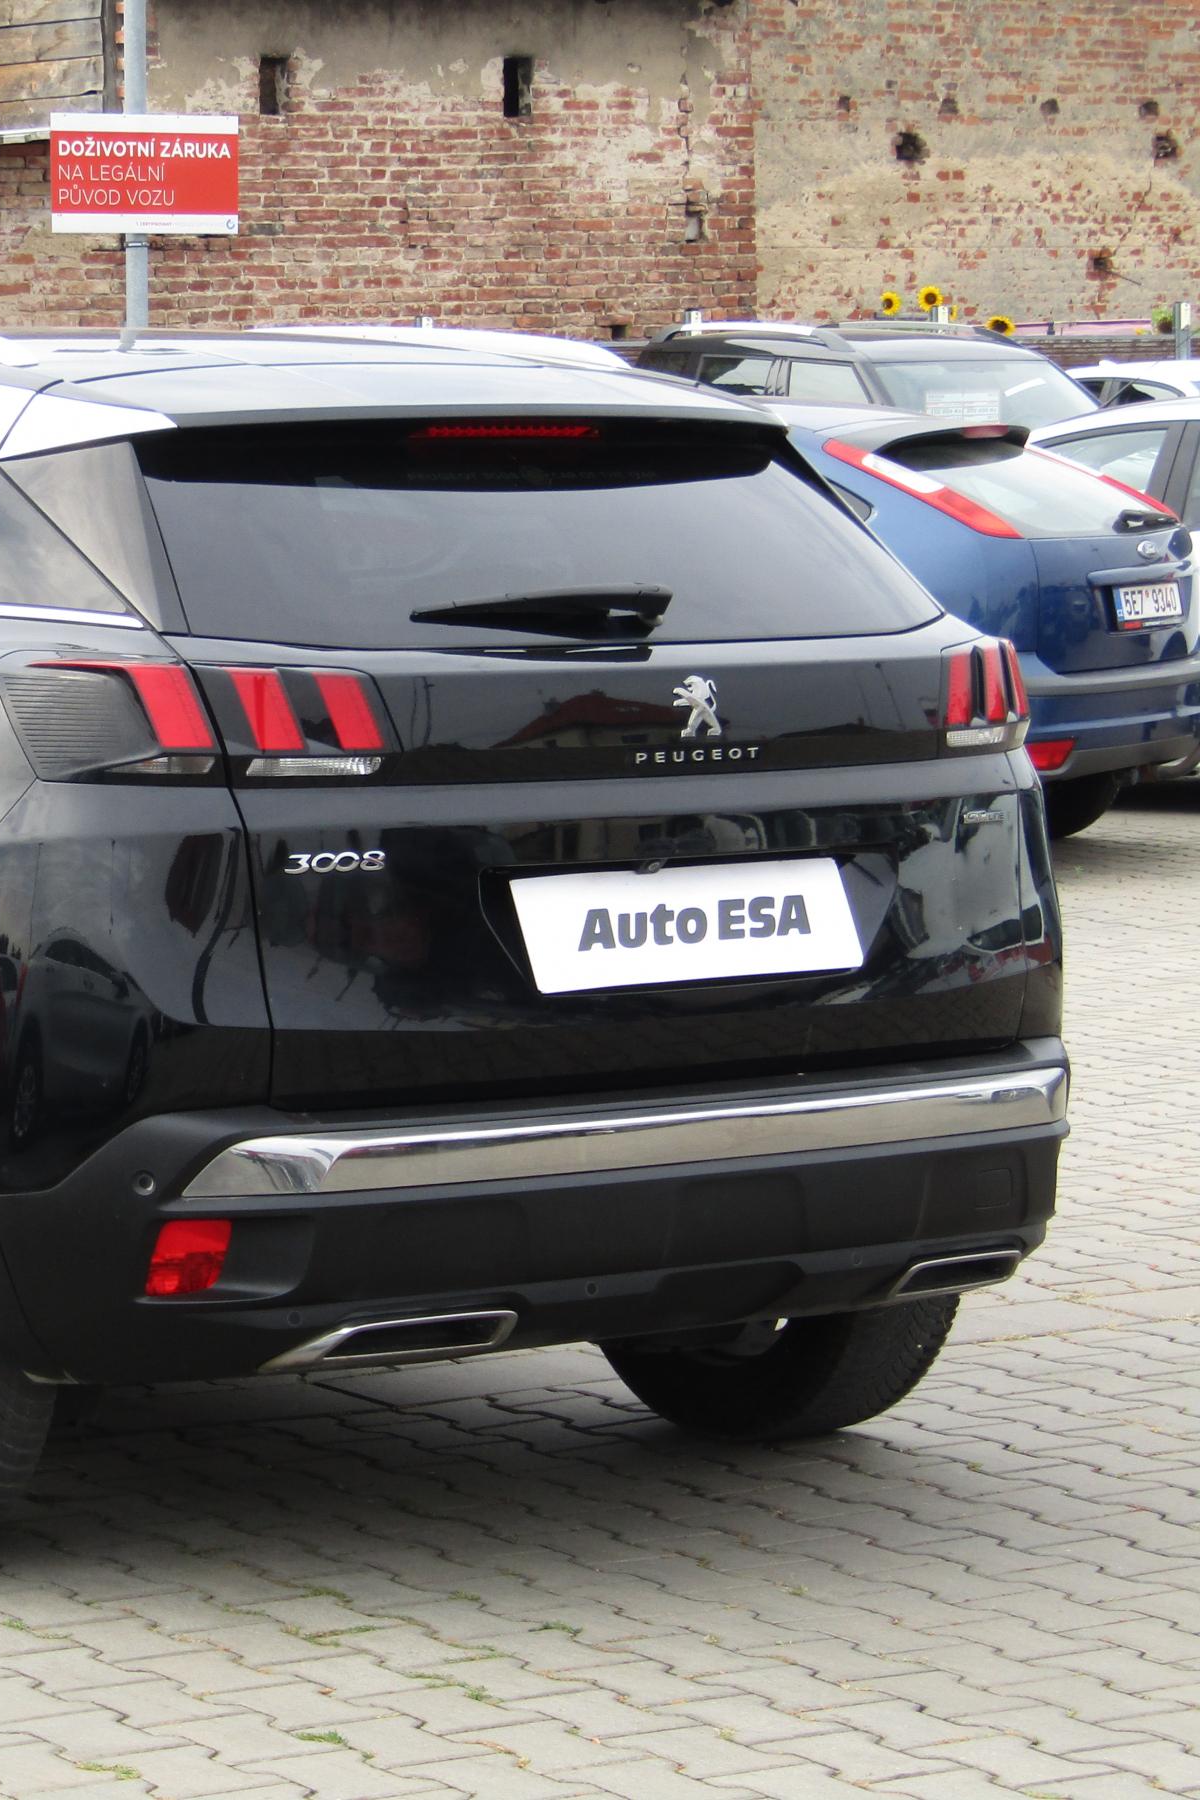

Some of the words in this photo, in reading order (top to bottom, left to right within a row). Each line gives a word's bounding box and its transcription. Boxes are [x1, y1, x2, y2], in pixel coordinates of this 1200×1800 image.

[58, 137, 155, 158] DOŽIVOTNÍ
[159, 138, 231, 159] ZÁRUKA
[58, 164, 84, 181] NA
[89, 162, 165, 182] LEGÁLNÍ
[58, 184, 121, 206] PŮVOD
[126, 189, 175, 206] VOZU
[1123, 590, 1144, 616] 5E7
[1151, 586, 1177, 613] 9340
[635, 747, 759, 764] PEUGEOT
[284, 850, 386, 875] 3008
[578, 903, 708, 952] Auto
[718, 894, 812, 941] ESA
